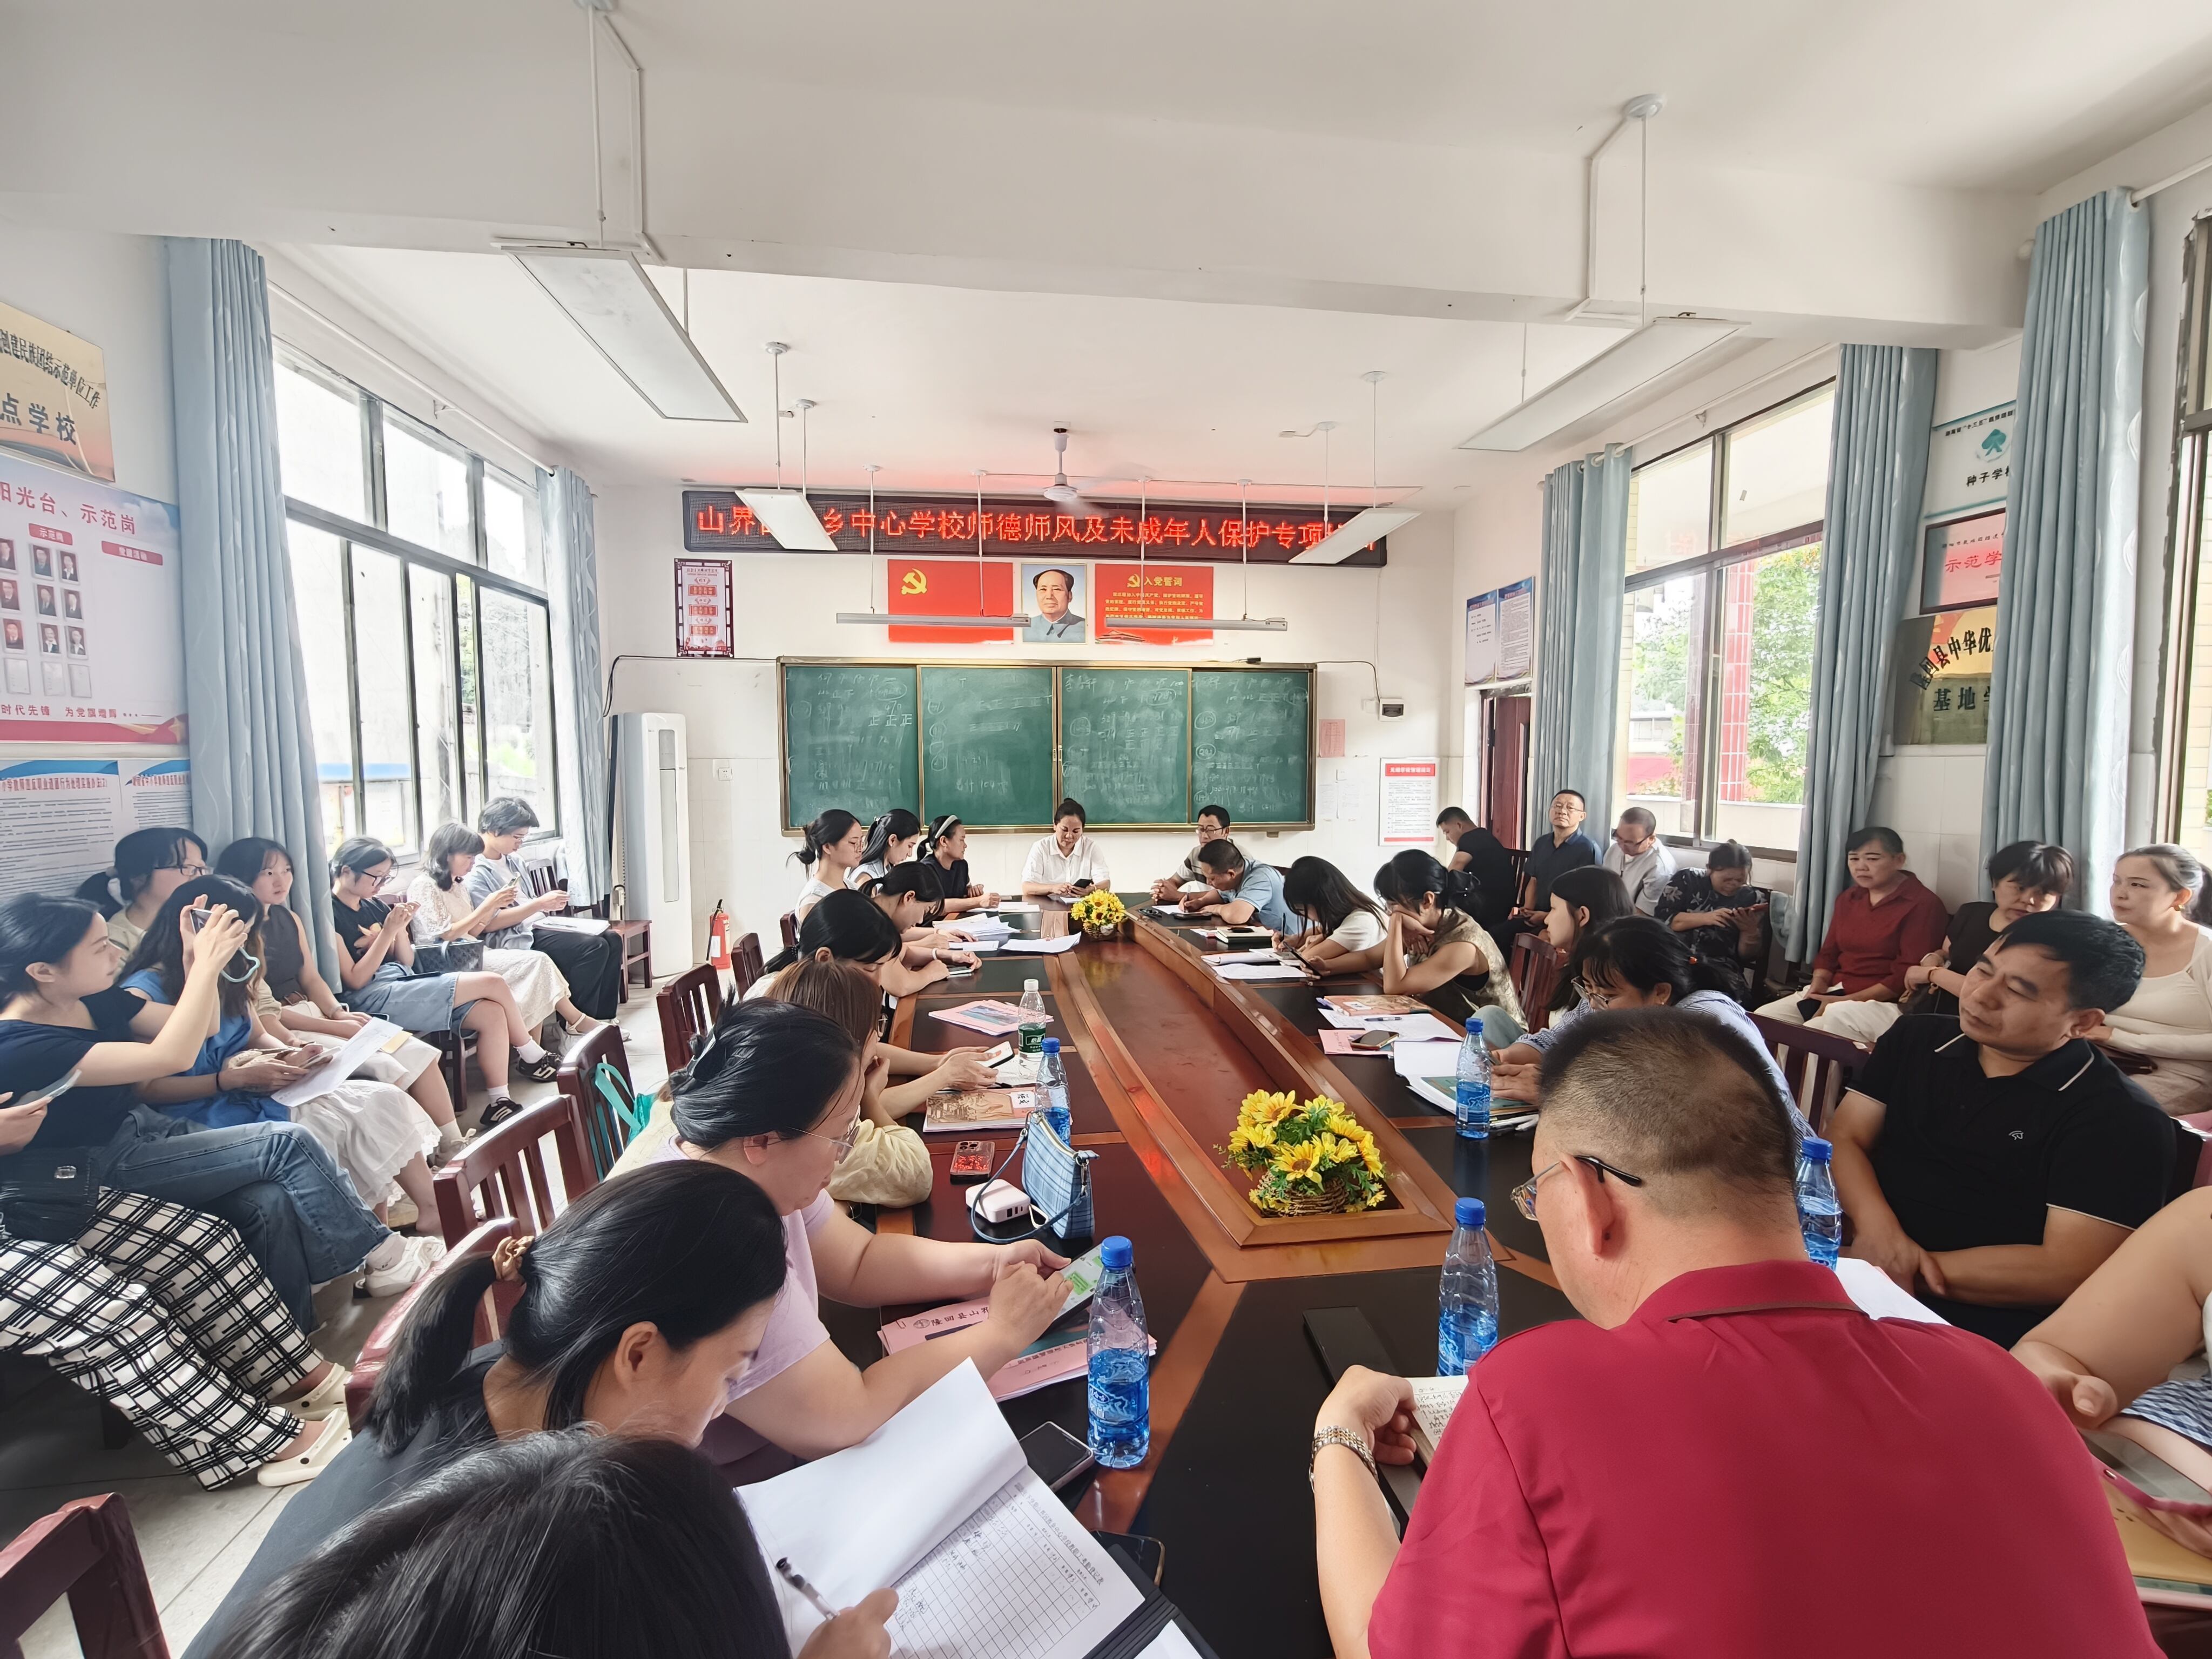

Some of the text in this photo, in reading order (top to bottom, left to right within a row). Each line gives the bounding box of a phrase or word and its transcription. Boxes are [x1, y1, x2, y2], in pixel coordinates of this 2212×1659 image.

[697, 505, 1373, 550] 山界乡中心学校师德师风及未成年人保护专项
[1144, 576, 1183, 586] 入党誓词
